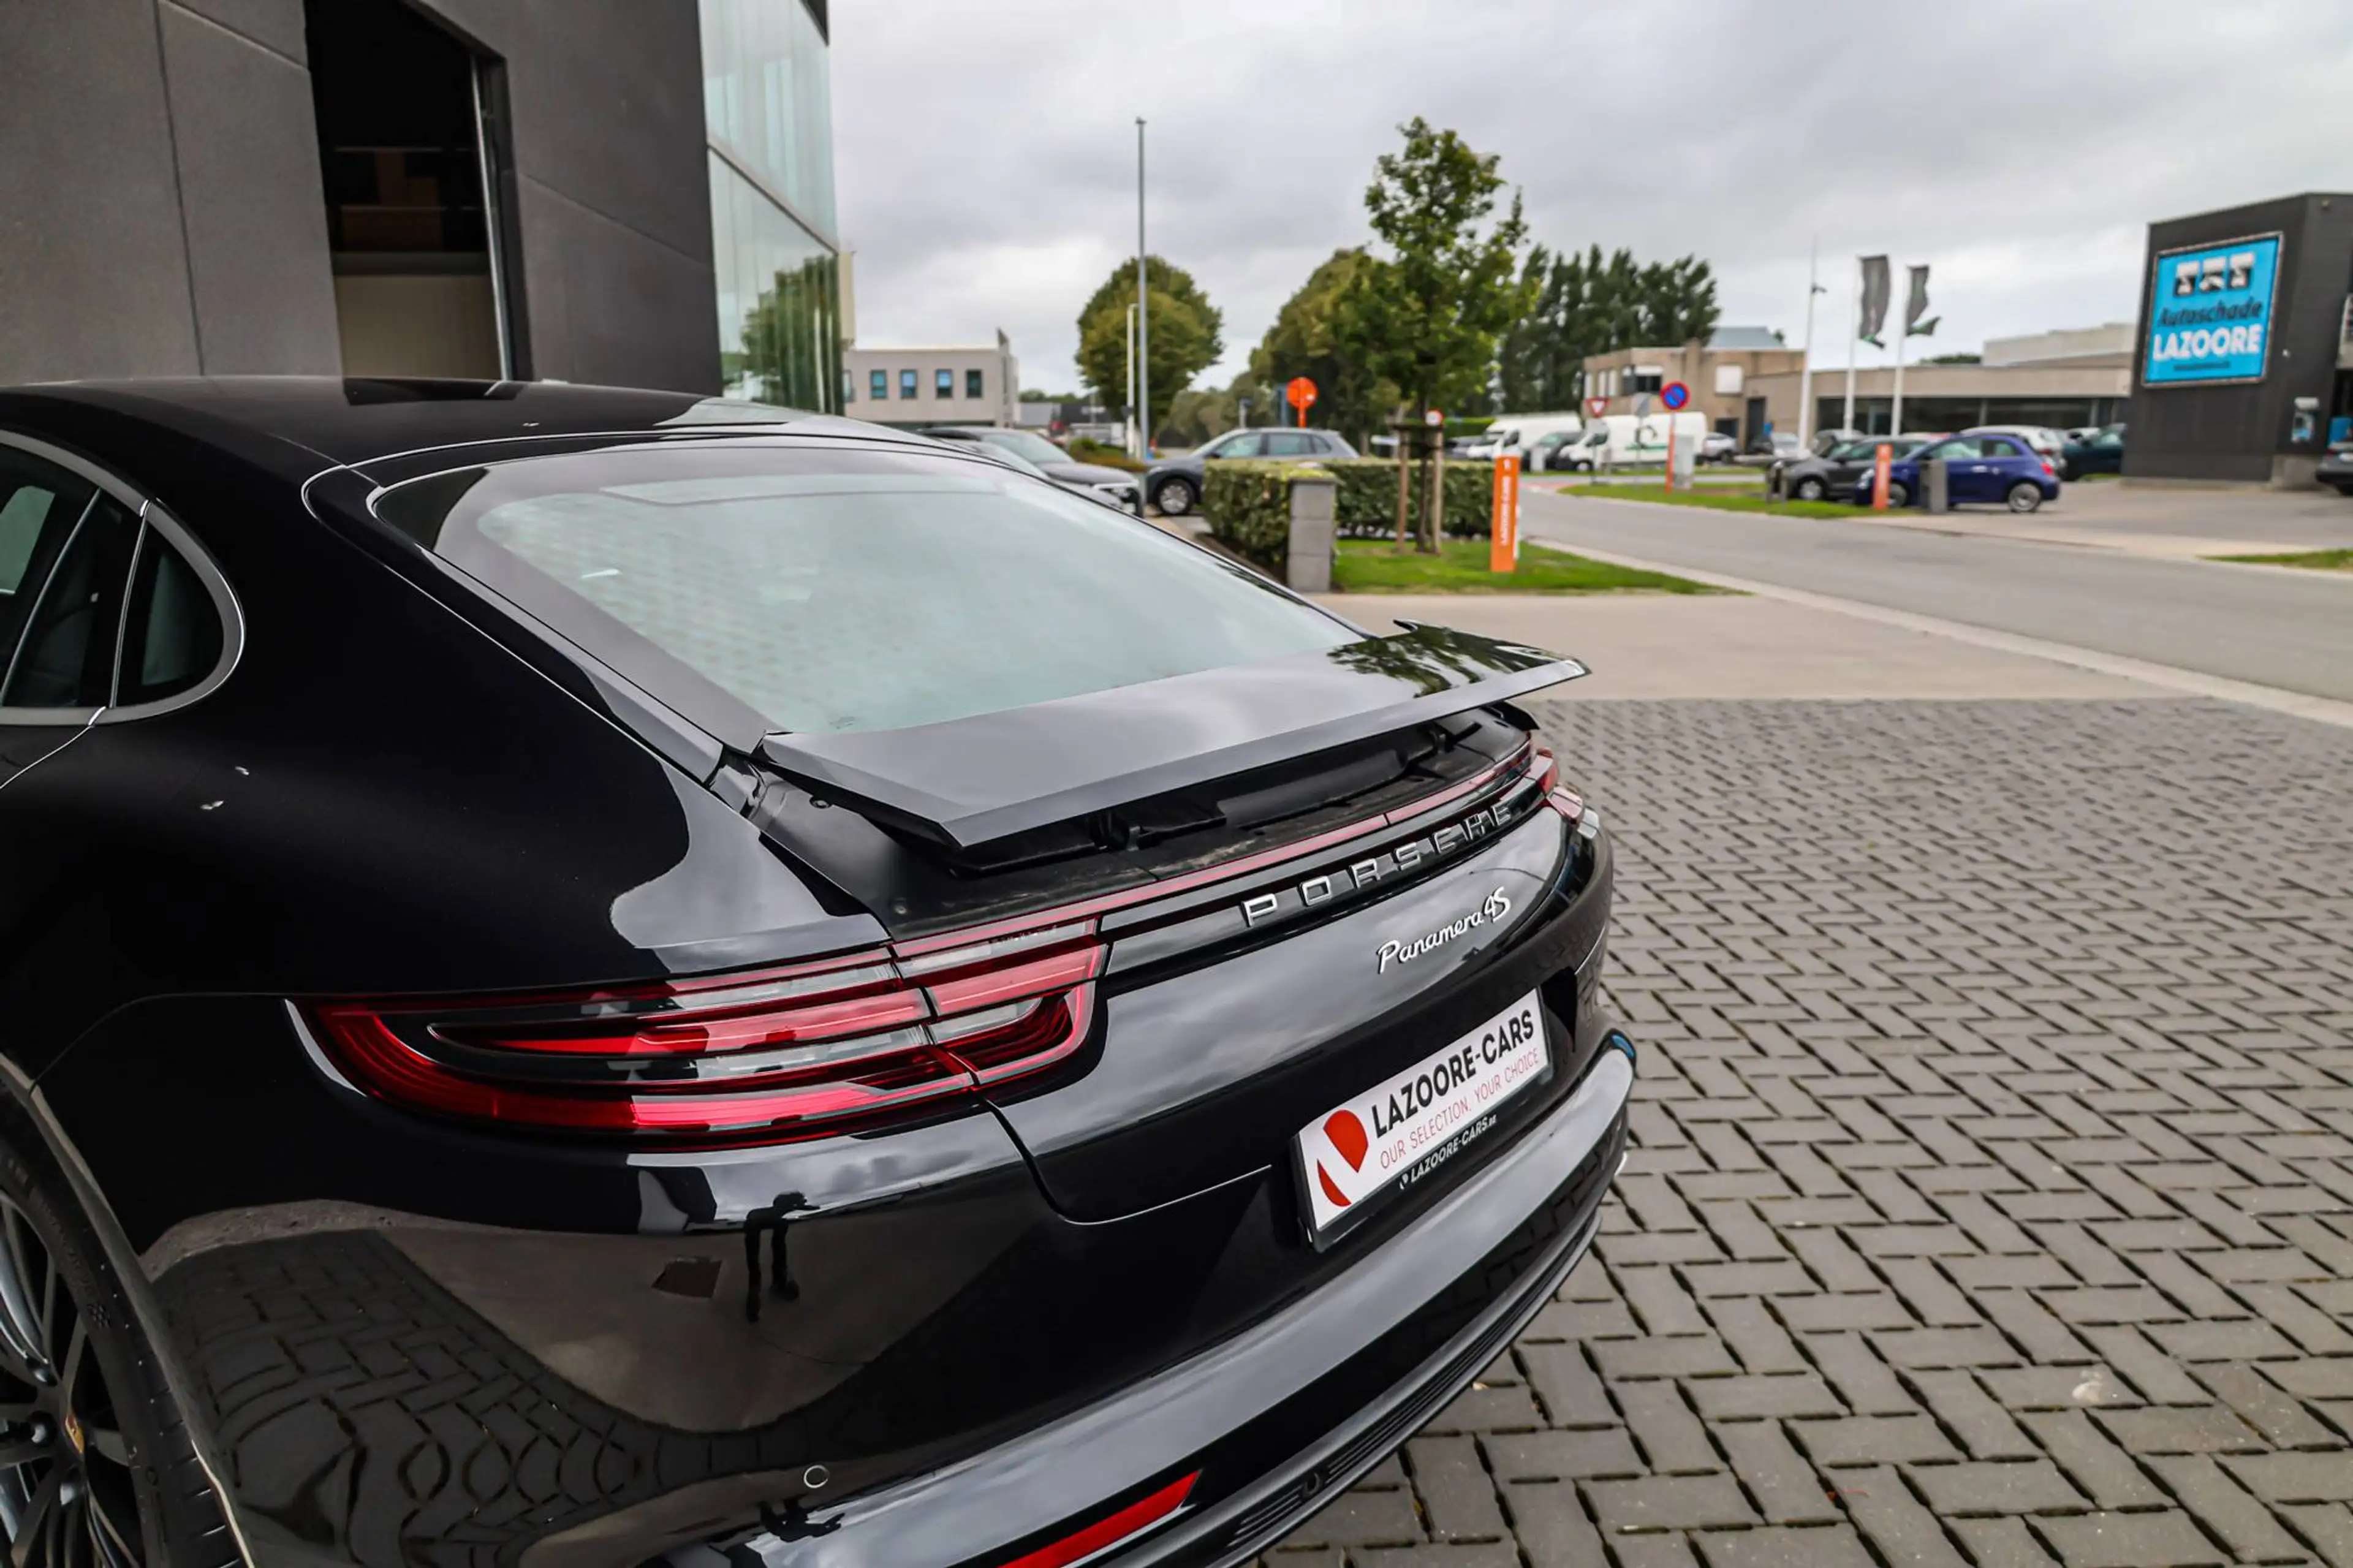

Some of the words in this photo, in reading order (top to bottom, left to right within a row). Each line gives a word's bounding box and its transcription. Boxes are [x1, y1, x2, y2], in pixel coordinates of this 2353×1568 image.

[2153, 324, 2262, 361] LAZOORE
[2158, 296, 2263, 327] Autoschade
[1241, 804, 1512, 926] PORSCHE
[1377, 912, 1483, 974] Panamera
[1371, 1009, 1534, 1138] LAZOORE-CARS
[1381, 1139, 1406, 1169] OUR
[1474, 1074, 1501, 1104] YOUR
[1504, 1047, 1539, 1083] CHOICE
